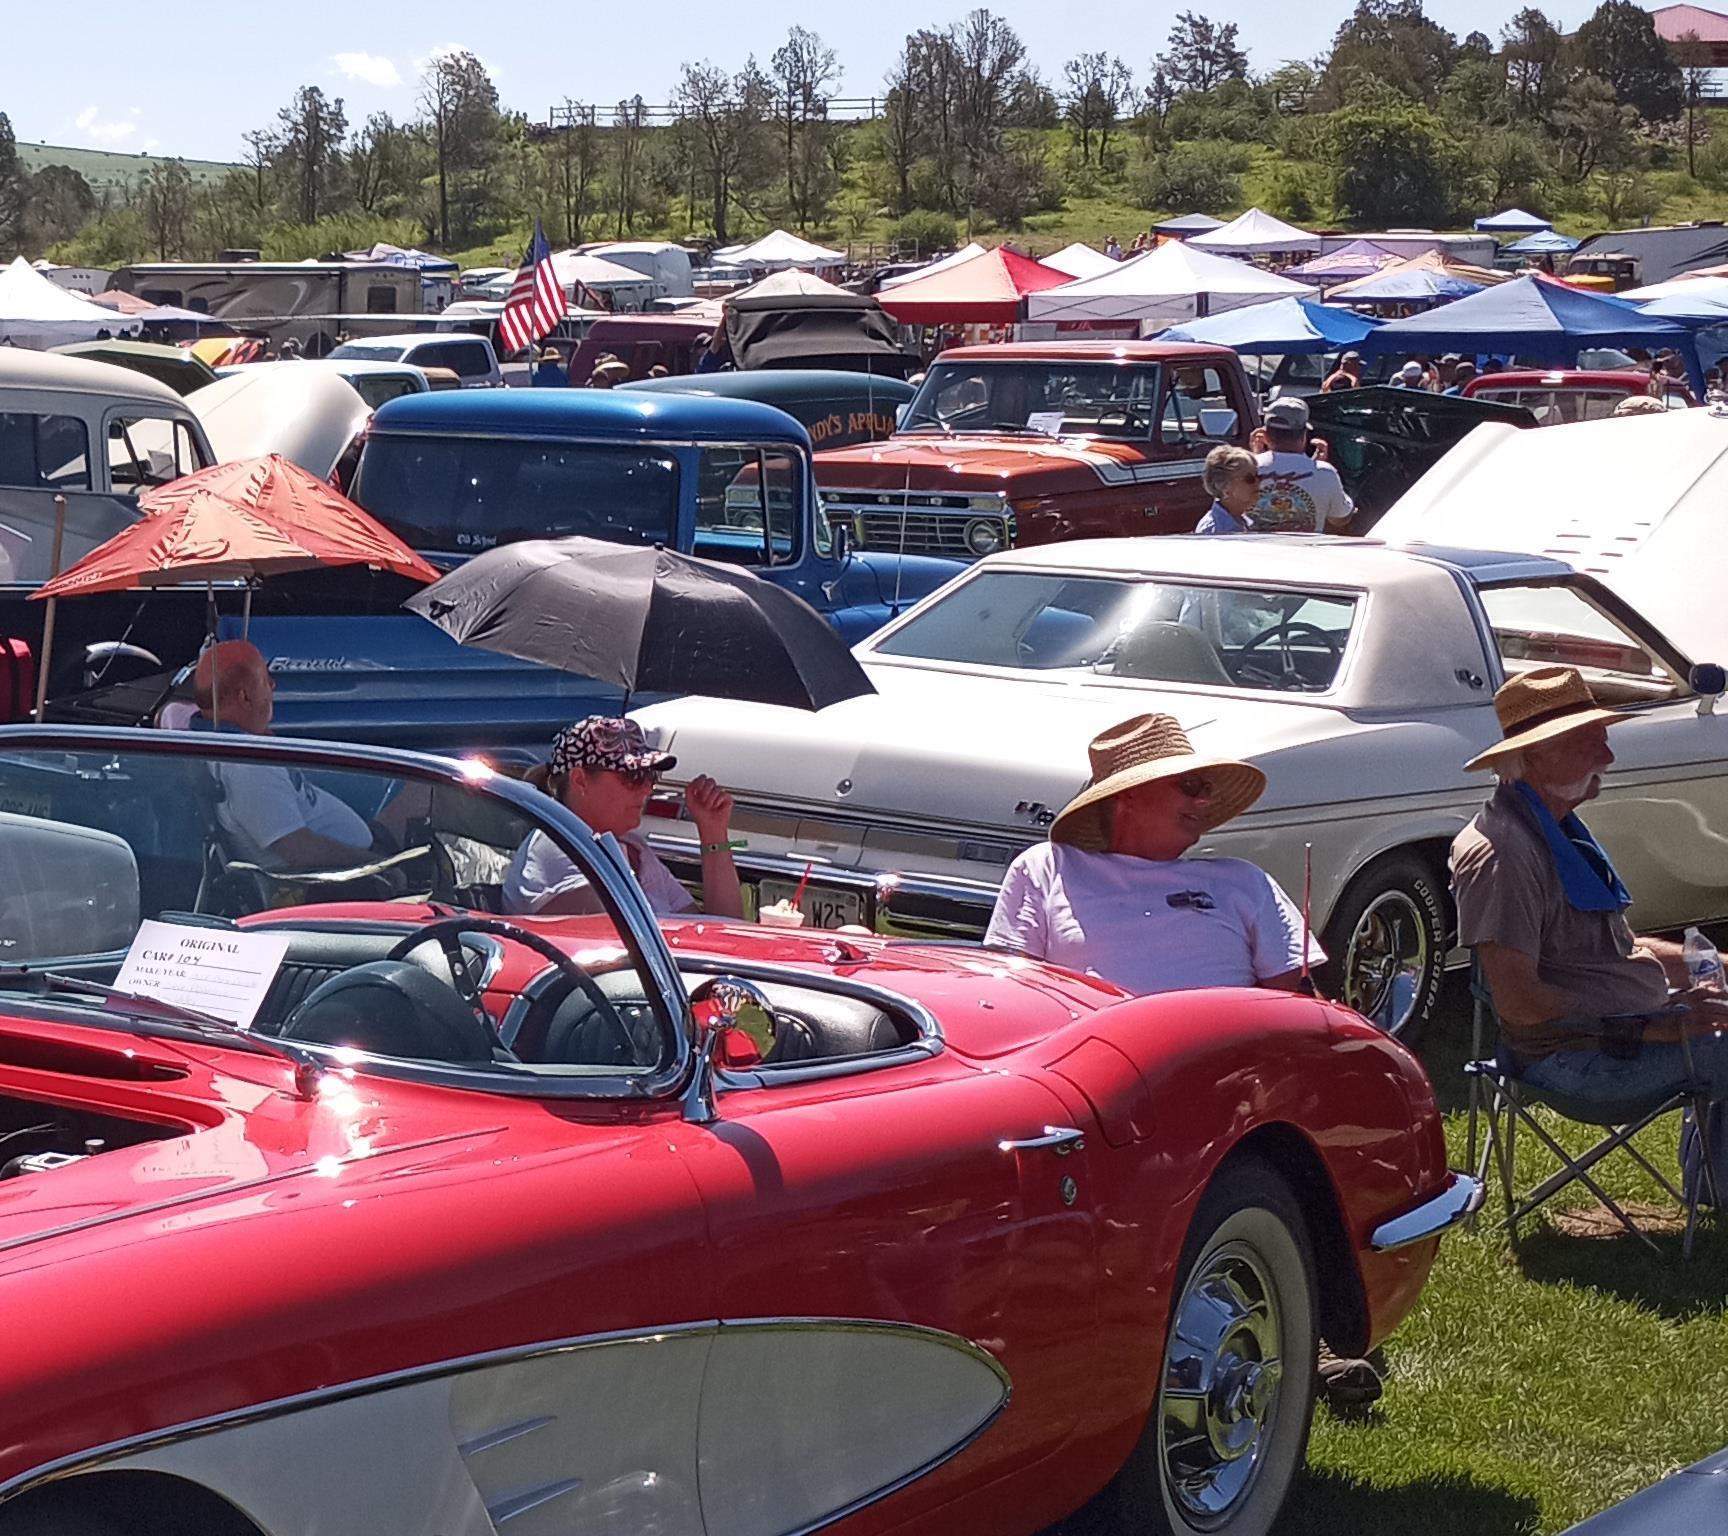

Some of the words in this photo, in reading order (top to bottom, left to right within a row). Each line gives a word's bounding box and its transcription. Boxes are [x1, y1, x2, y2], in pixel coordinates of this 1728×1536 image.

[1413, 879, 1442, 943] COOPER
[142, 950, 174, 962] CAR#
[180, 938, 240, 954] ORIGINAL
[1422, 950, 1442, 1020] COBRA
